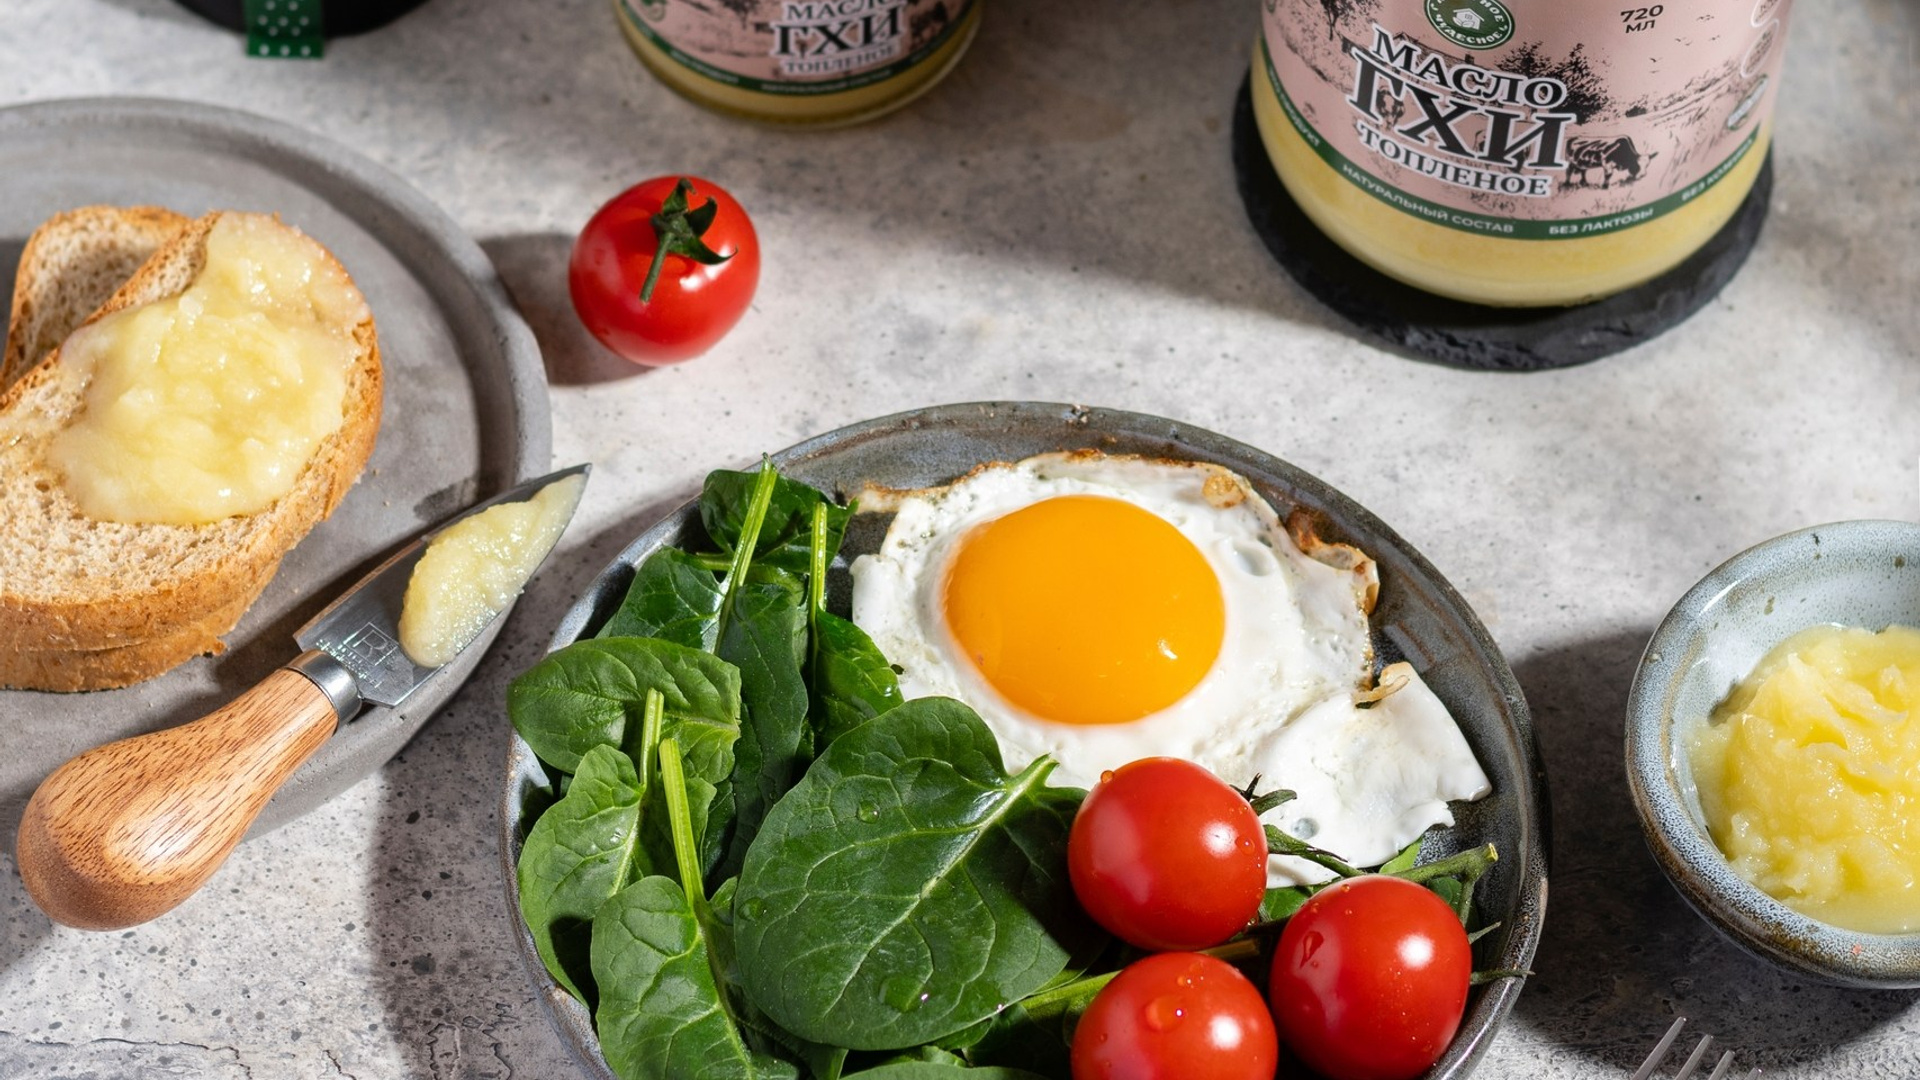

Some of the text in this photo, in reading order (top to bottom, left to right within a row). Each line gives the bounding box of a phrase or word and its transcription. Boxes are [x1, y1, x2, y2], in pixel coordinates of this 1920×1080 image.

[775, 5, 900, 56] ГХИ
[1436, 14, 1504, 45] ЧУДЕСНОЕ
[1620, 4, 1664, 23] 720
[1625, 20, 1656, 34] МЛ
[785, 45, 894, 74] ТОПЛЕНОЕ
[1373, 25, 1565, 107] МАСЛО
[1349, 51, 1577, 167] ГХИ
[1360, 123, 1549, 196] ТОПЛЕНОЕ
[1342, 163, 1514, 234] НАТУРАЛЬНЫЙ СОСТАВ
[1548, 208, 1654, 236] БЕЗ ЛАКТОЗЫ
